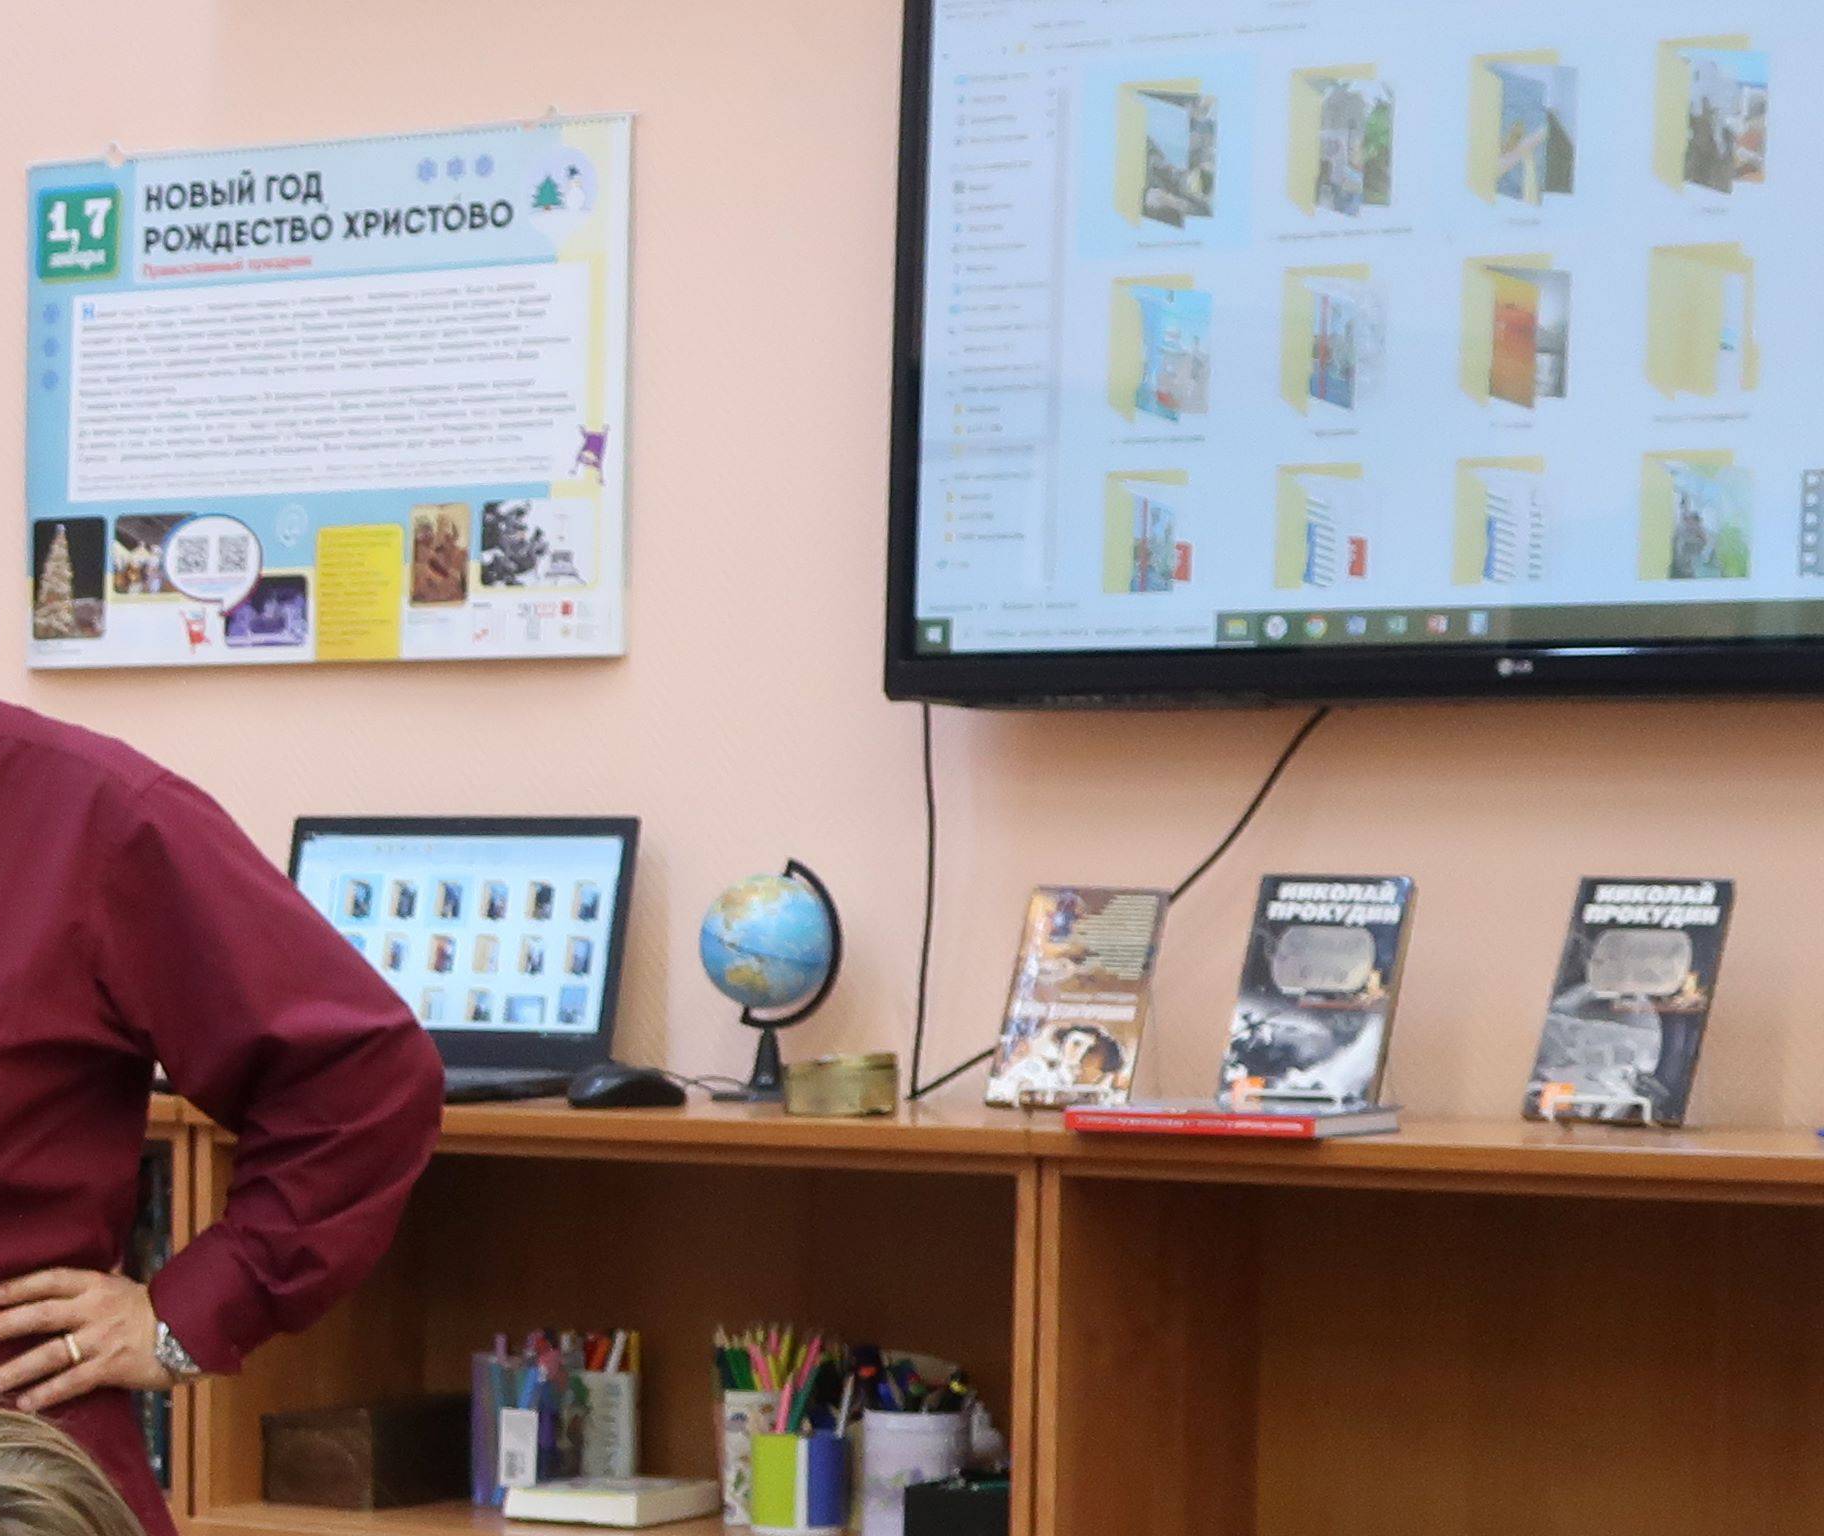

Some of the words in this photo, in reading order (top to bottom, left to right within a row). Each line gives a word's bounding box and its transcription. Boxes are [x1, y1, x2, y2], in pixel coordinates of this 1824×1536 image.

[144, 169, 256, 213] НОВЫЙ
[265, 170, 325, 206] ГОД
[143, 212, 334, 255] РОЖДЕСТВО
[342, 197, 515, 242] ХРИСТОВО
[1277, 880, 1398, 904] НИКОЛАЙ
[1593, 879, 1718, 905] НИКОЛАЙ
[1266, 900, 1401, 926] ПРОКУДИН
[1582, 902, 1722, 928] ПРОКУДИН
